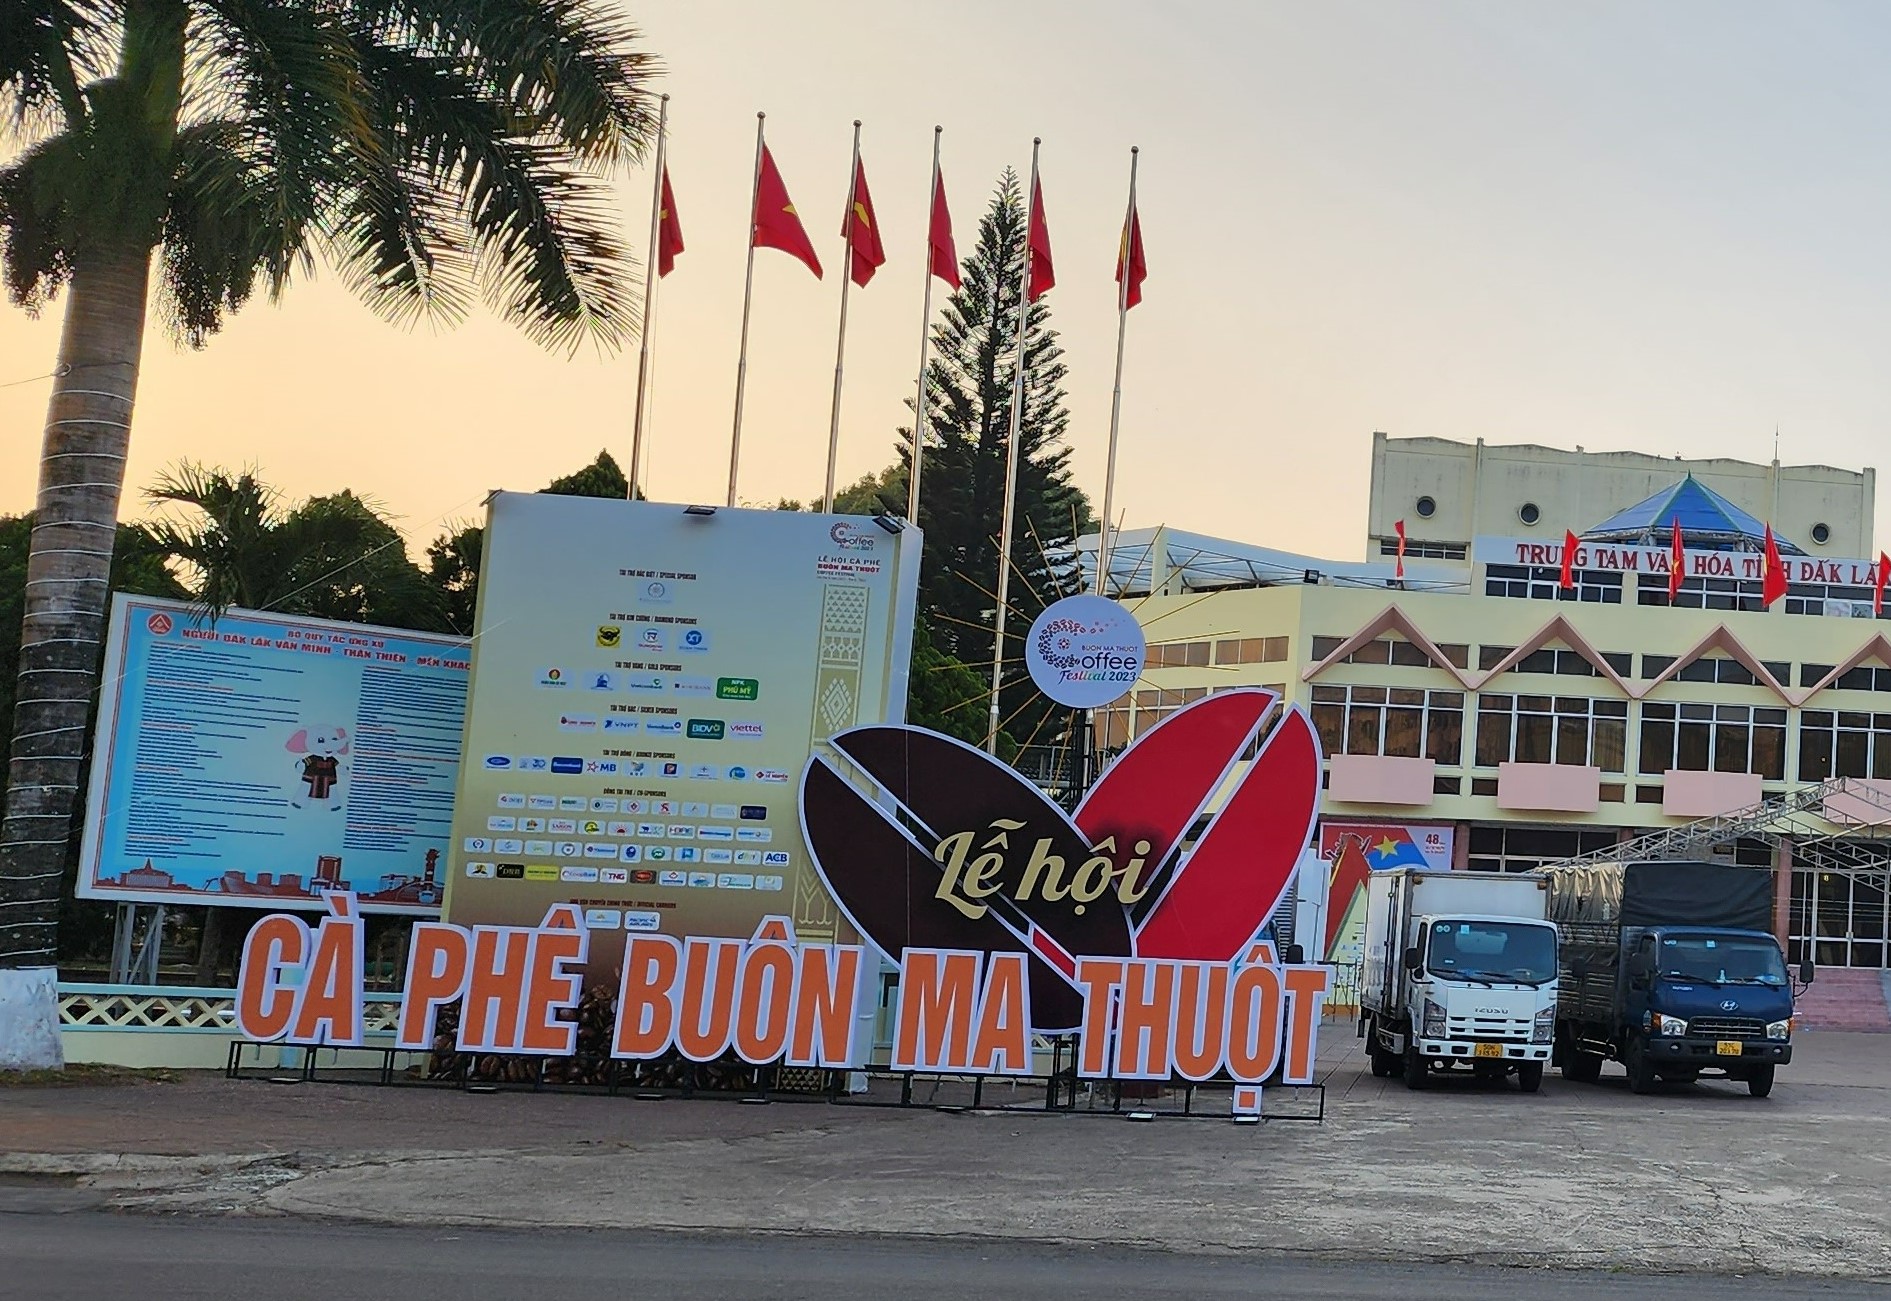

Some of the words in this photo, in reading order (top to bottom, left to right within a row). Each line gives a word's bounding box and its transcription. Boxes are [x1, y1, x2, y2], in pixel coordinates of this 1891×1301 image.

[1693, 552, 1735, 576] HÓA
[1742, 553, 1792, 580] TỈH
[1800, 559, 1843, 583] ĐẮK
[301, 643, 331, 654] MINH
[1108, 671, 1137, 682] 2023
[691, 723, 714, 732] BIDV
[730, 724, 763, 733] viettel
[599, 763, 617, 772] MB
[1425, 833, 1439, 845] 48
[765, 852, 788, 862] ACB
[933, 818, 1027, 920] Lễ
[1015, 836, 1155, 915] hội
[608, 872, 625, 880] TNG
[237, 891, 360, 1045] CÀ
[400, 904, 586, 1053] PHÊ
[613, 916, 861, 1064] BUÔN
[894, 950, 1030, 1072] MA
[1077, 943, 1328, 1111] THUỘT
